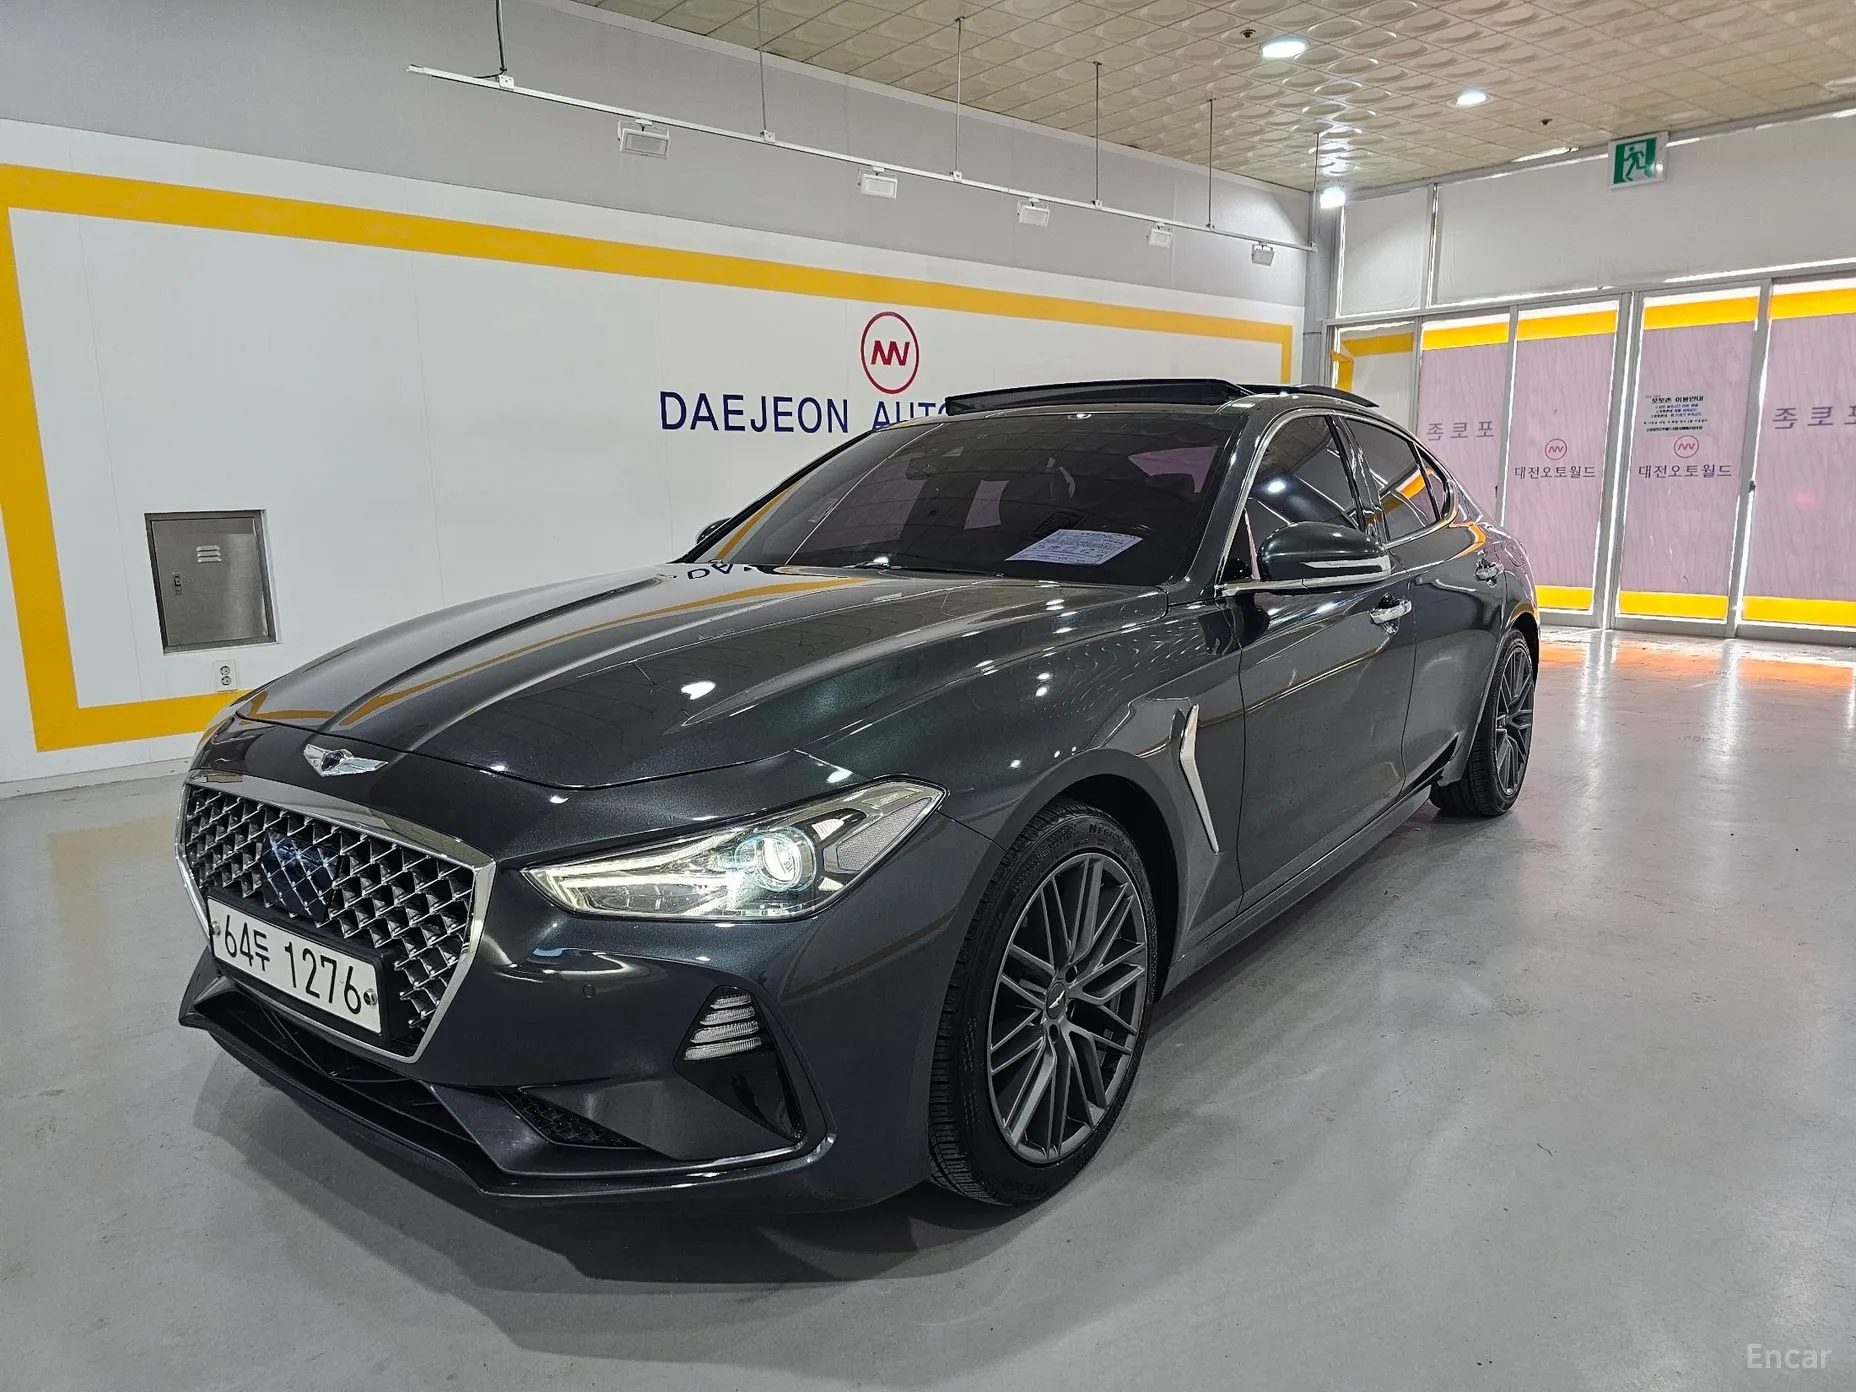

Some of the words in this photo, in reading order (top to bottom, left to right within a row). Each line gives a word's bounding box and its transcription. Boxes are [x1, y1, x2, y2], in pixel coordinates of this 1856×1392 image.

[660, 391, 848, 433] DAEJEON
[872, 401, 946, 430] AUT
[1514, 465, 1596, 479] 대전오토월드
[1638, 464, 1732, 479] 대전오토월드
[224, 914, 271, 972] 64두
[285, 941, 362, 1015] 1276
